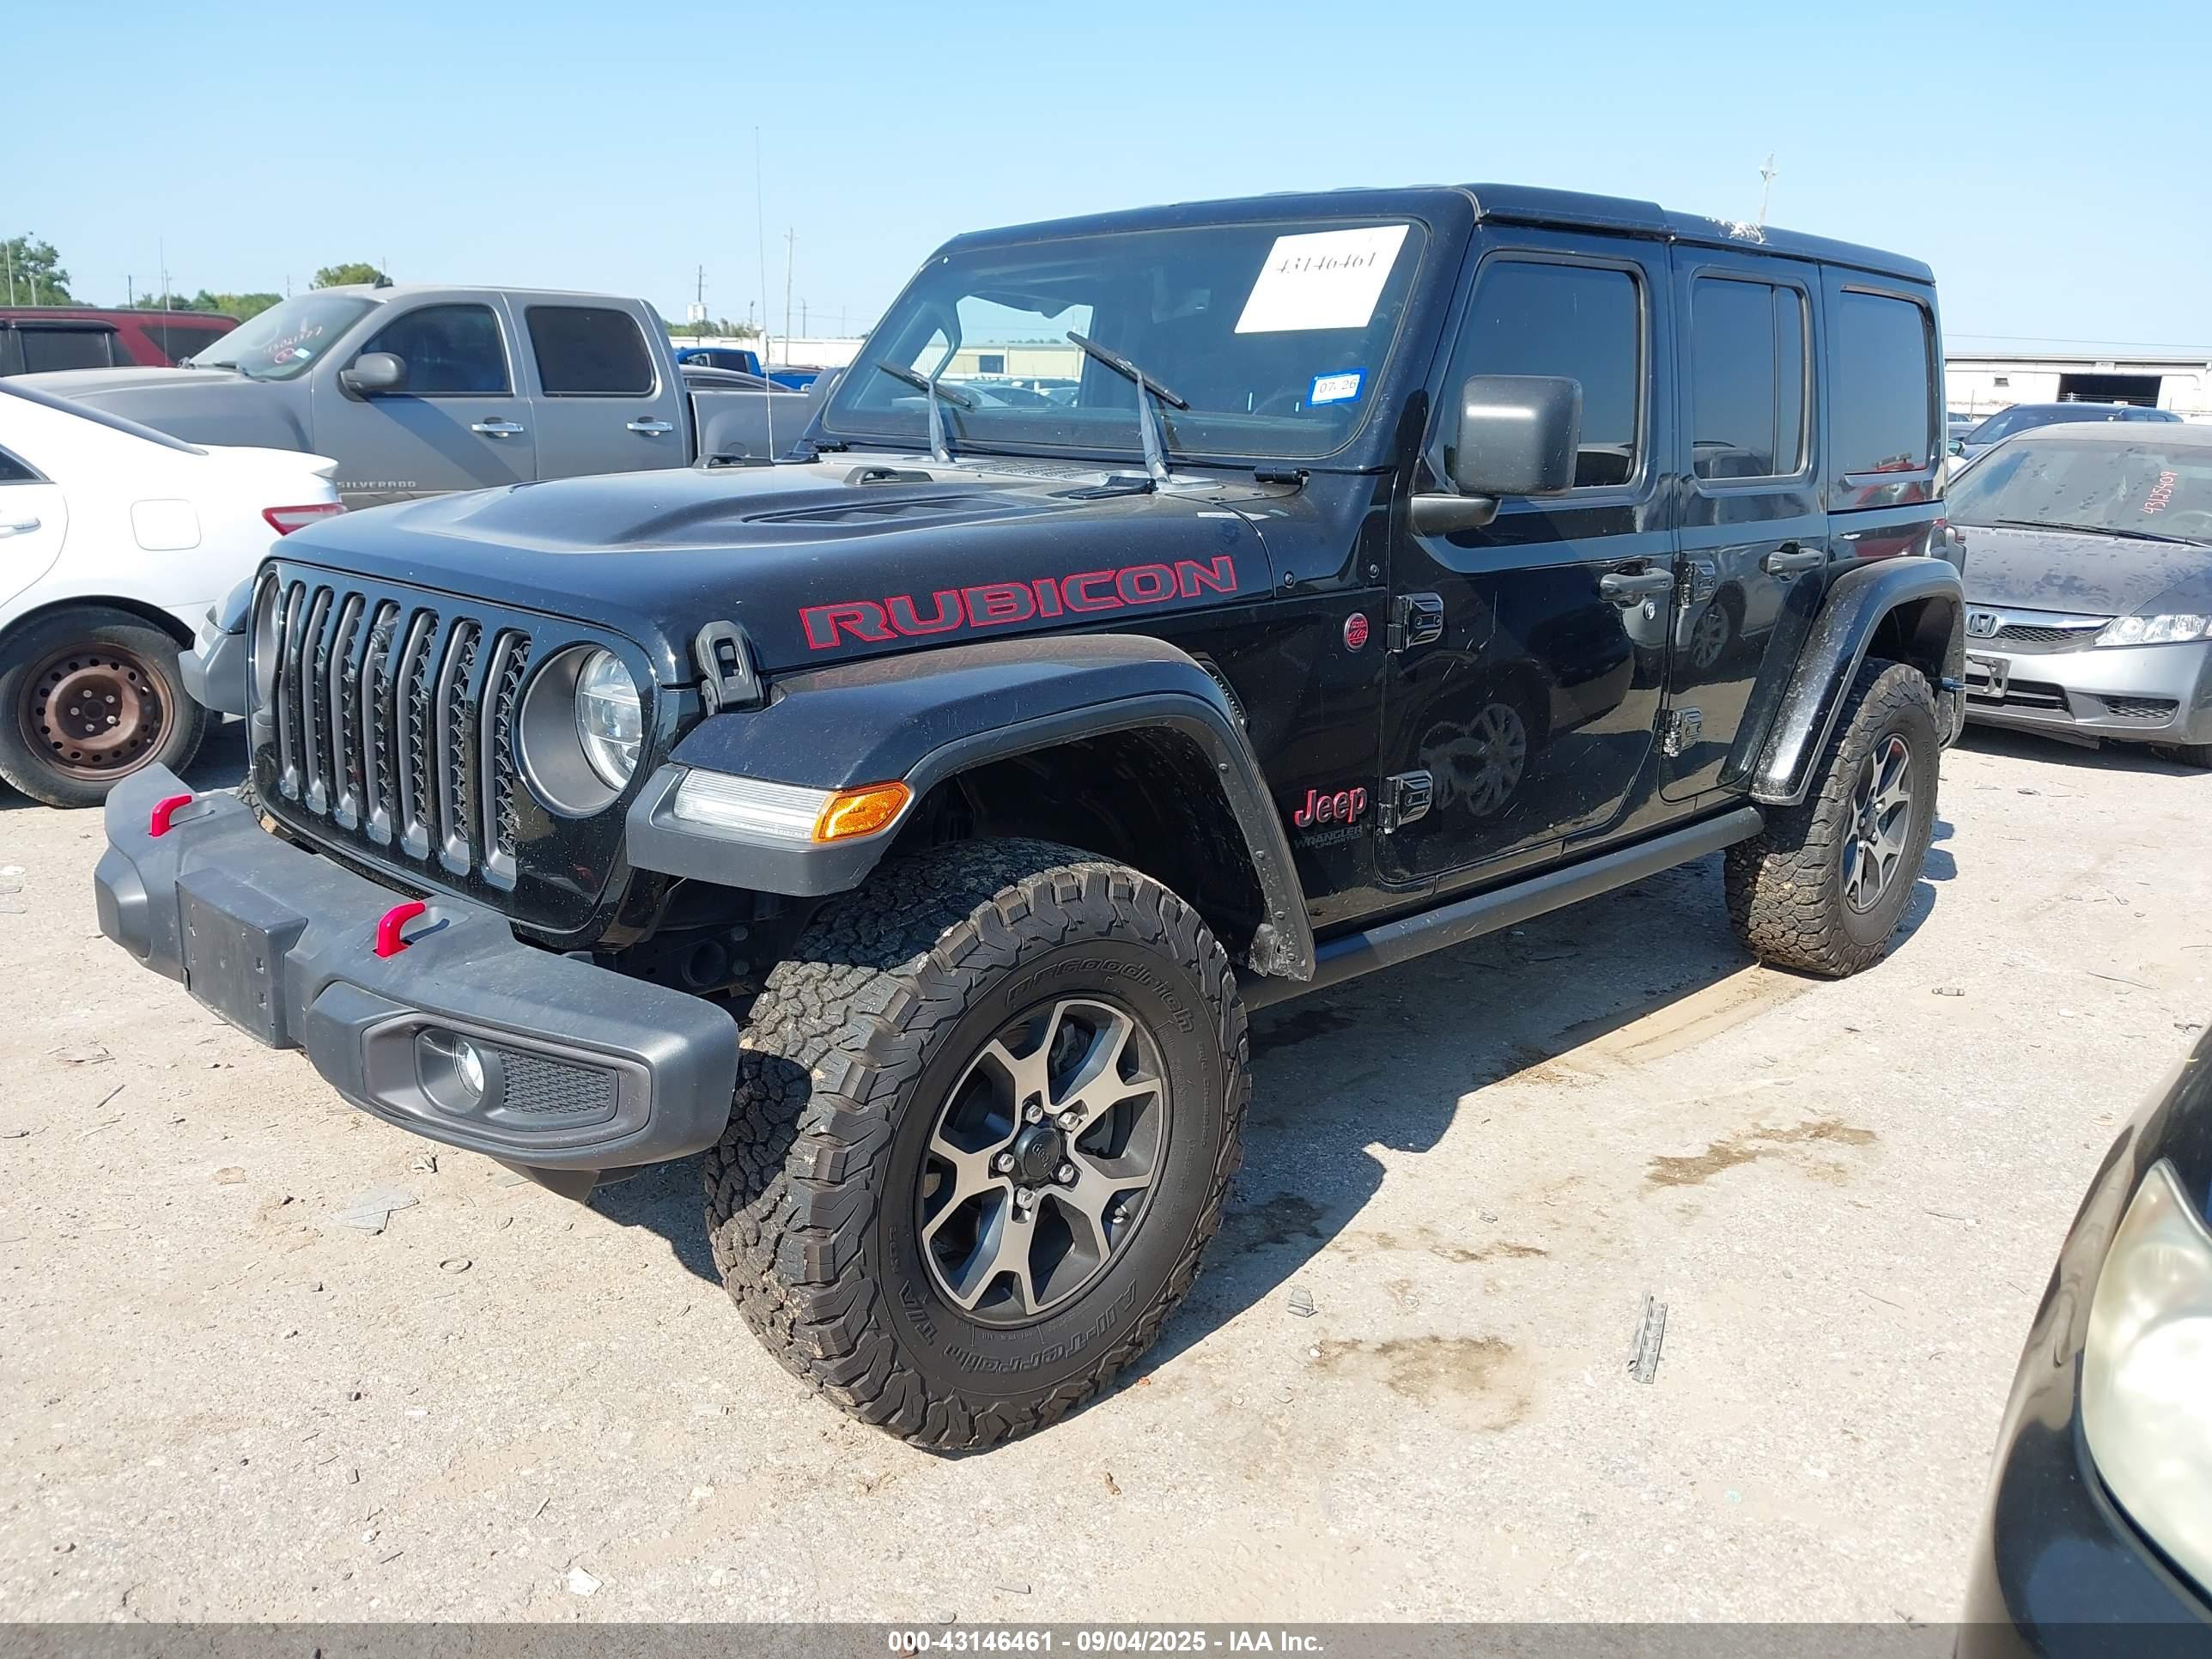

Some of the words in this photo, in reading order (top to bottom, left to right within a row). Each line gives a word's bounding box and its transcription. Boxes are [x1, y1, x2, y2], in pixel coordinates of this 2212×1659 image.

[1276, 251, 1377, 274] 43146461
[336, 480, 416, 489] SILVERADO
[2136, 471, 2179, 514] 43125409
[799, 556, 1237, 650] RUBICON
[1293, 787, 1368, 828] Jeep
[1295, 825, 1361, 849] WRANGLER
